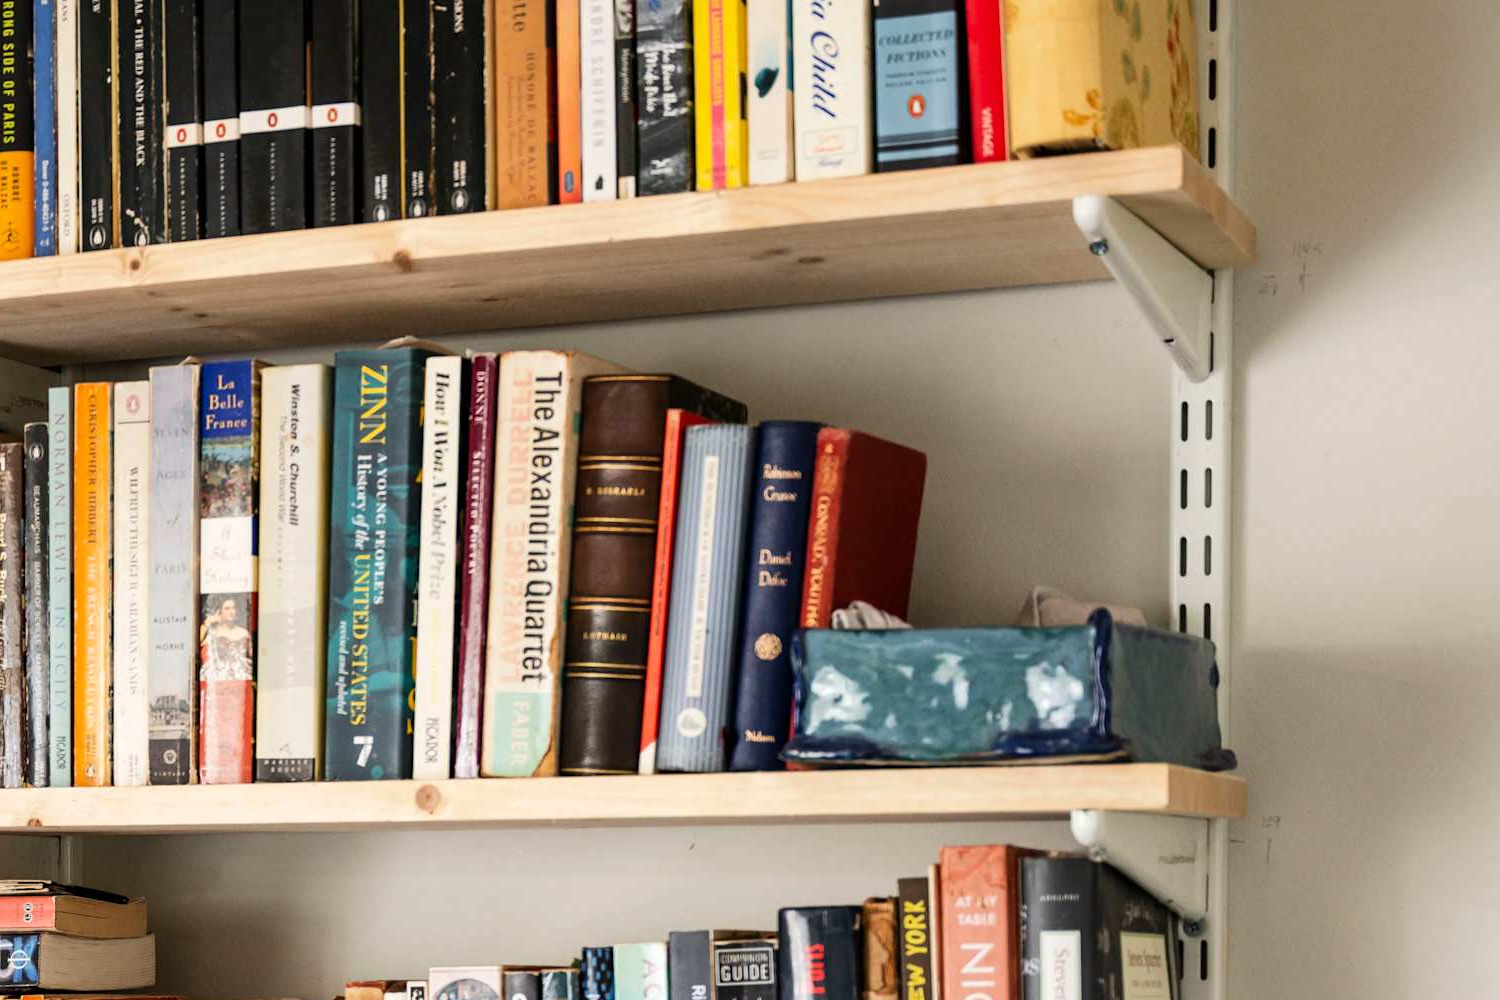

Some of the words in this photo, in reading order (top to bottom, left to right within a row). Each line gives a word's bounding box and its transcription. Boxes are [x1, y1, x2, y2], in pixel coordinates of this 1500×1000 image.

[2, 40, 15, 75] SIDE
[810, 30, 840, 119] Child
[2, 80, 15, 98] OF
[2, 103, 16, 145] PARIS
[208, 391, 245, 410] Belle
[216, 373, 235, 391] La
[359, 364, 389, 446] ZINN
[535, 371, 563, 420] The
[205, 413, 248, 432] France
[289, 382, 301, 441] Winston
[288, 461, 300, 527] Churchill
[527, 426, 561, 577] Alexandria
[351, 554, 372, 638] UNITED
[521, 580, 556, 684] Quartet
[349, 643, 369, 728] STATES
[903, 899, 927, 955] YORK
[720, 963, 770, 982] GUIDE
